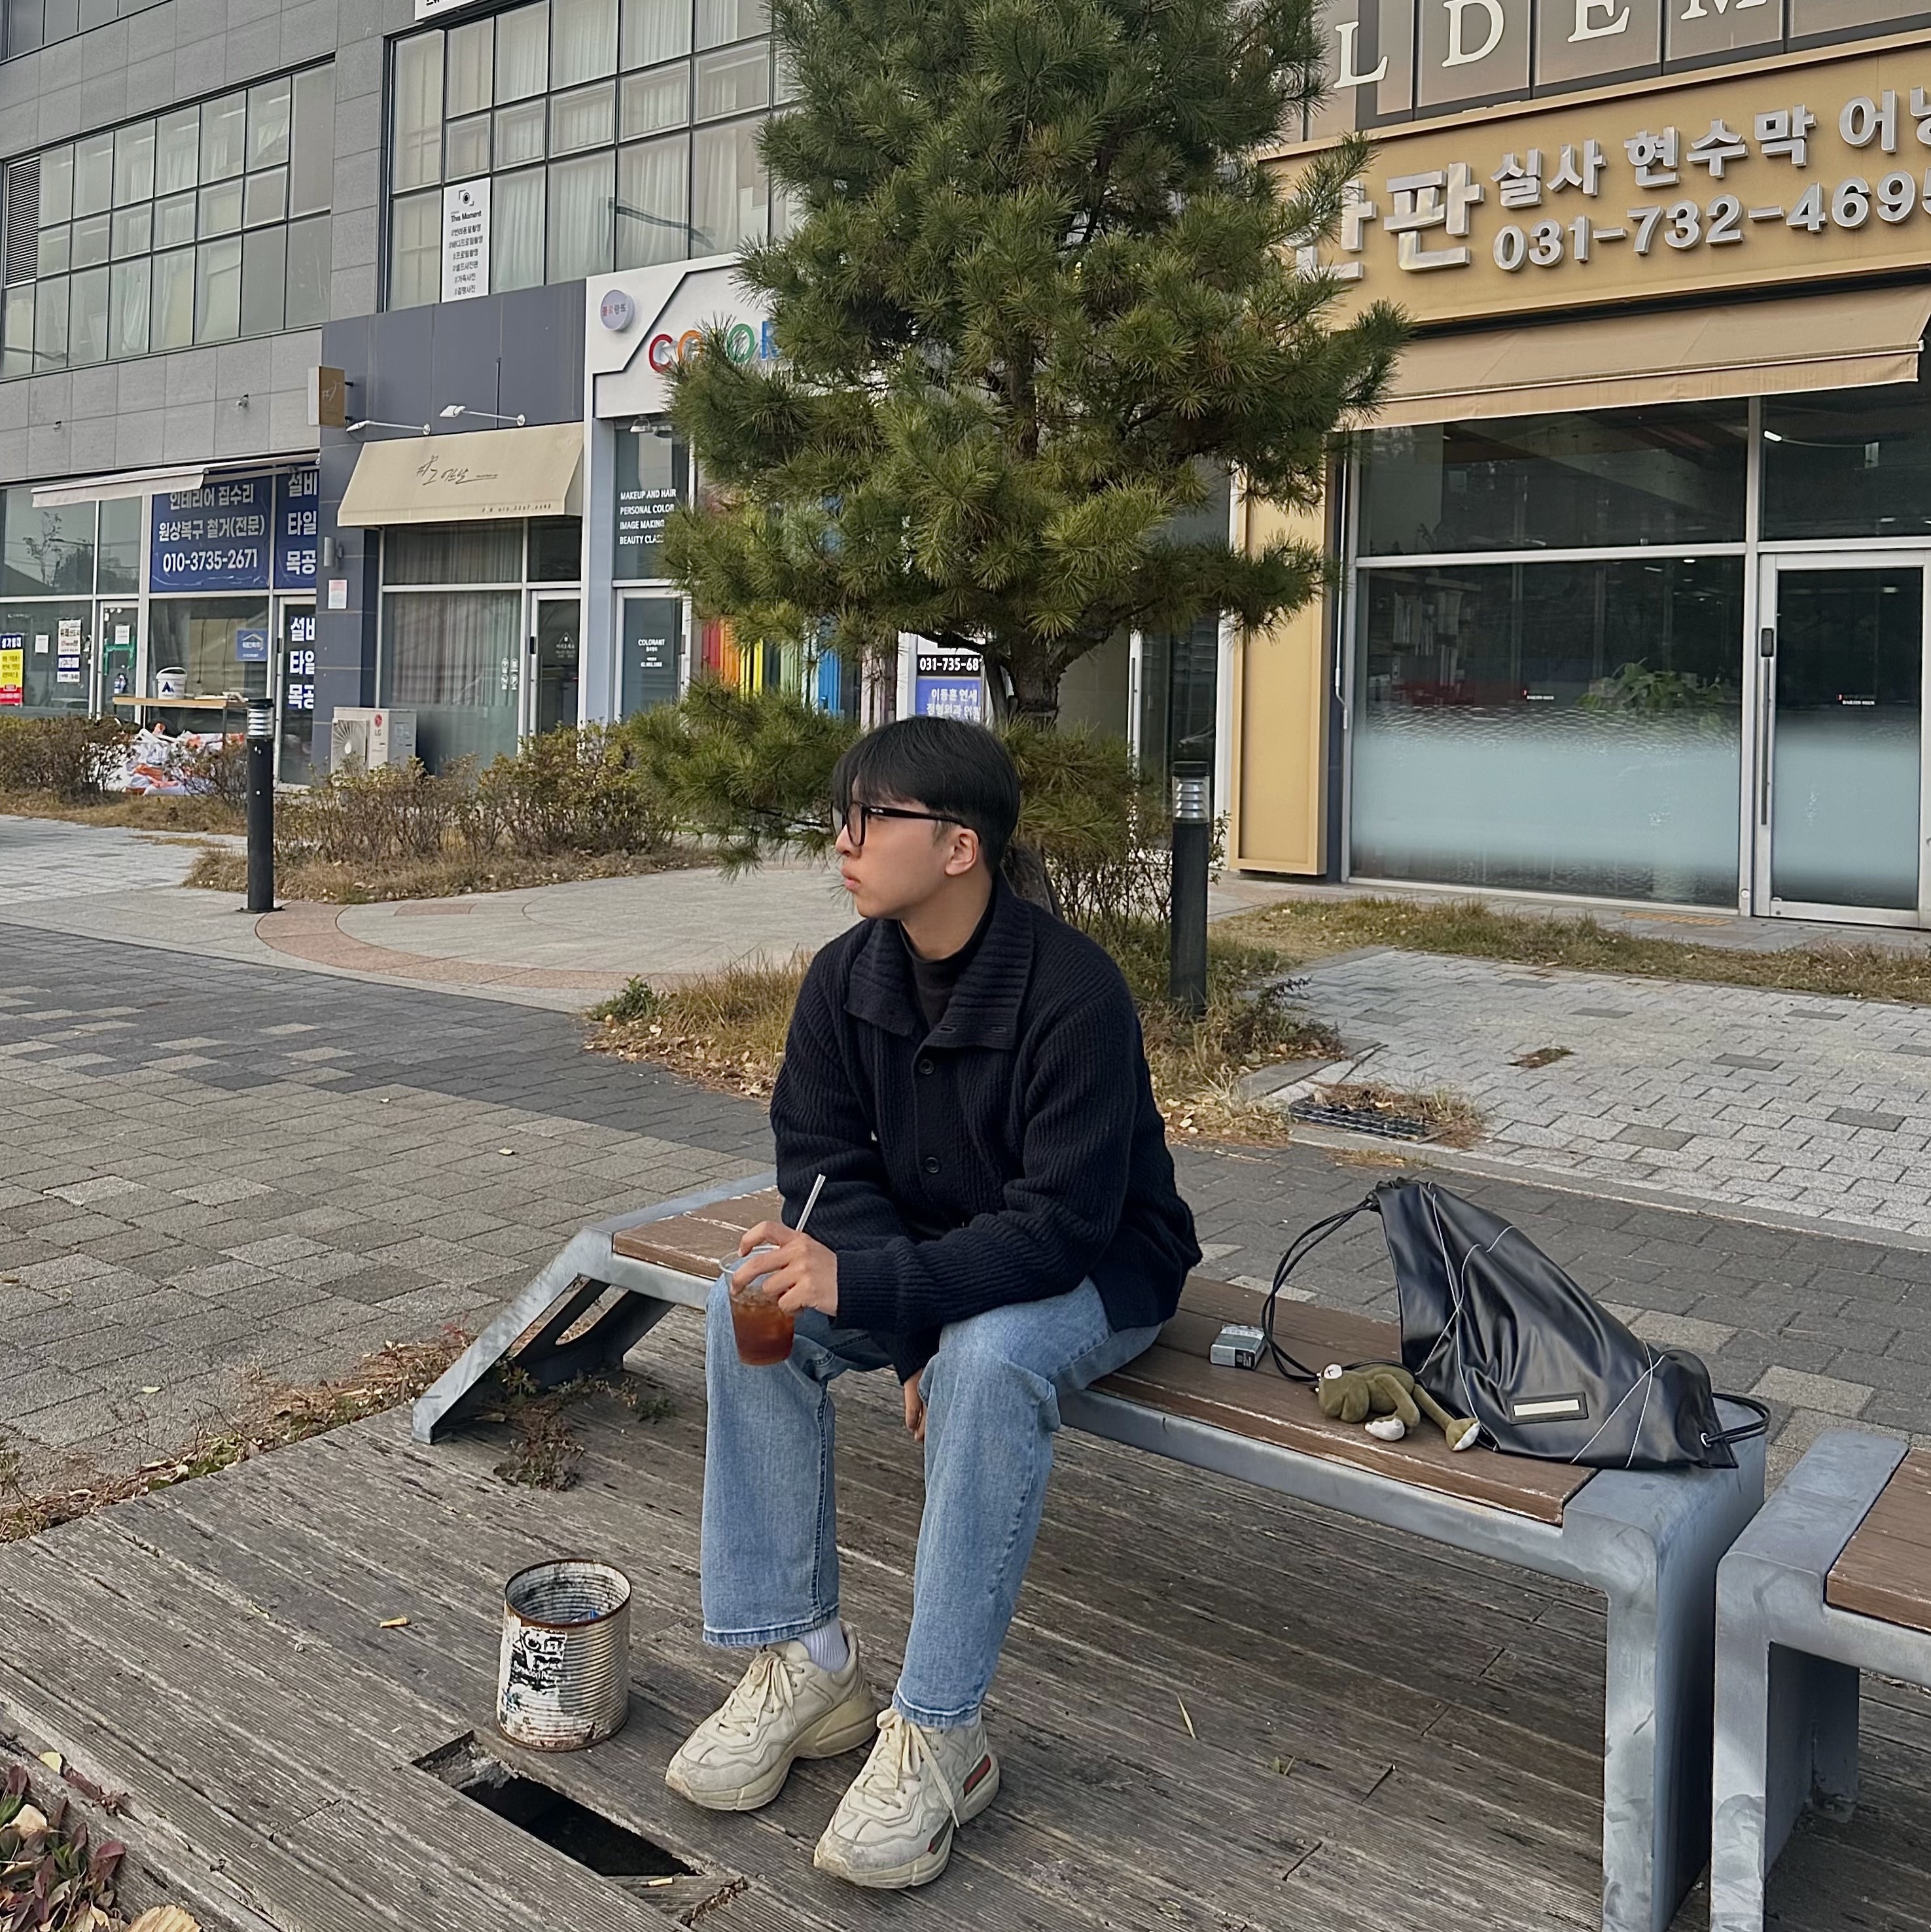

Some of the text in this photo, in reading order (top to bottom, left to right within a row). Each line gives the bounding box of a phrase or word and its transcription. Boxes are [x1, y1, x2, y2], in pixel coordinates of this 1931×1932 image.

[1490, 138, 1606, 209] 실사
[1623, 104, 1817, 189] 현수막
[461, 210, 482, 220] Moment
[1492, 167, 1931, 273] 031-732-469
[169, 483, 254, 510] 인테리어 집수리
[289, 472, 317, 497] 설비
[620, 489, 677, 500] MAKEUP AND HAIR
[620, 504, 675, 515] PERSONAL COLOR
[159, 514, 265, 542] 원상복구 철거(전문)
[287, 511, 317, 536] 타일
[619, 520, 639, 530] IMAGE
[619, 535, 644, 544] BEAUTY
[163, 548, 258, 572] 010-3735-2671
[286, 550, 316, 575] 목공
[919, 658, 982, 671] 031-735-68
[288, 684, 315, 709] 목공
[931, 688, 978, 703] 이동훈 연세
[927, 703, 963, 718] 정형외과
